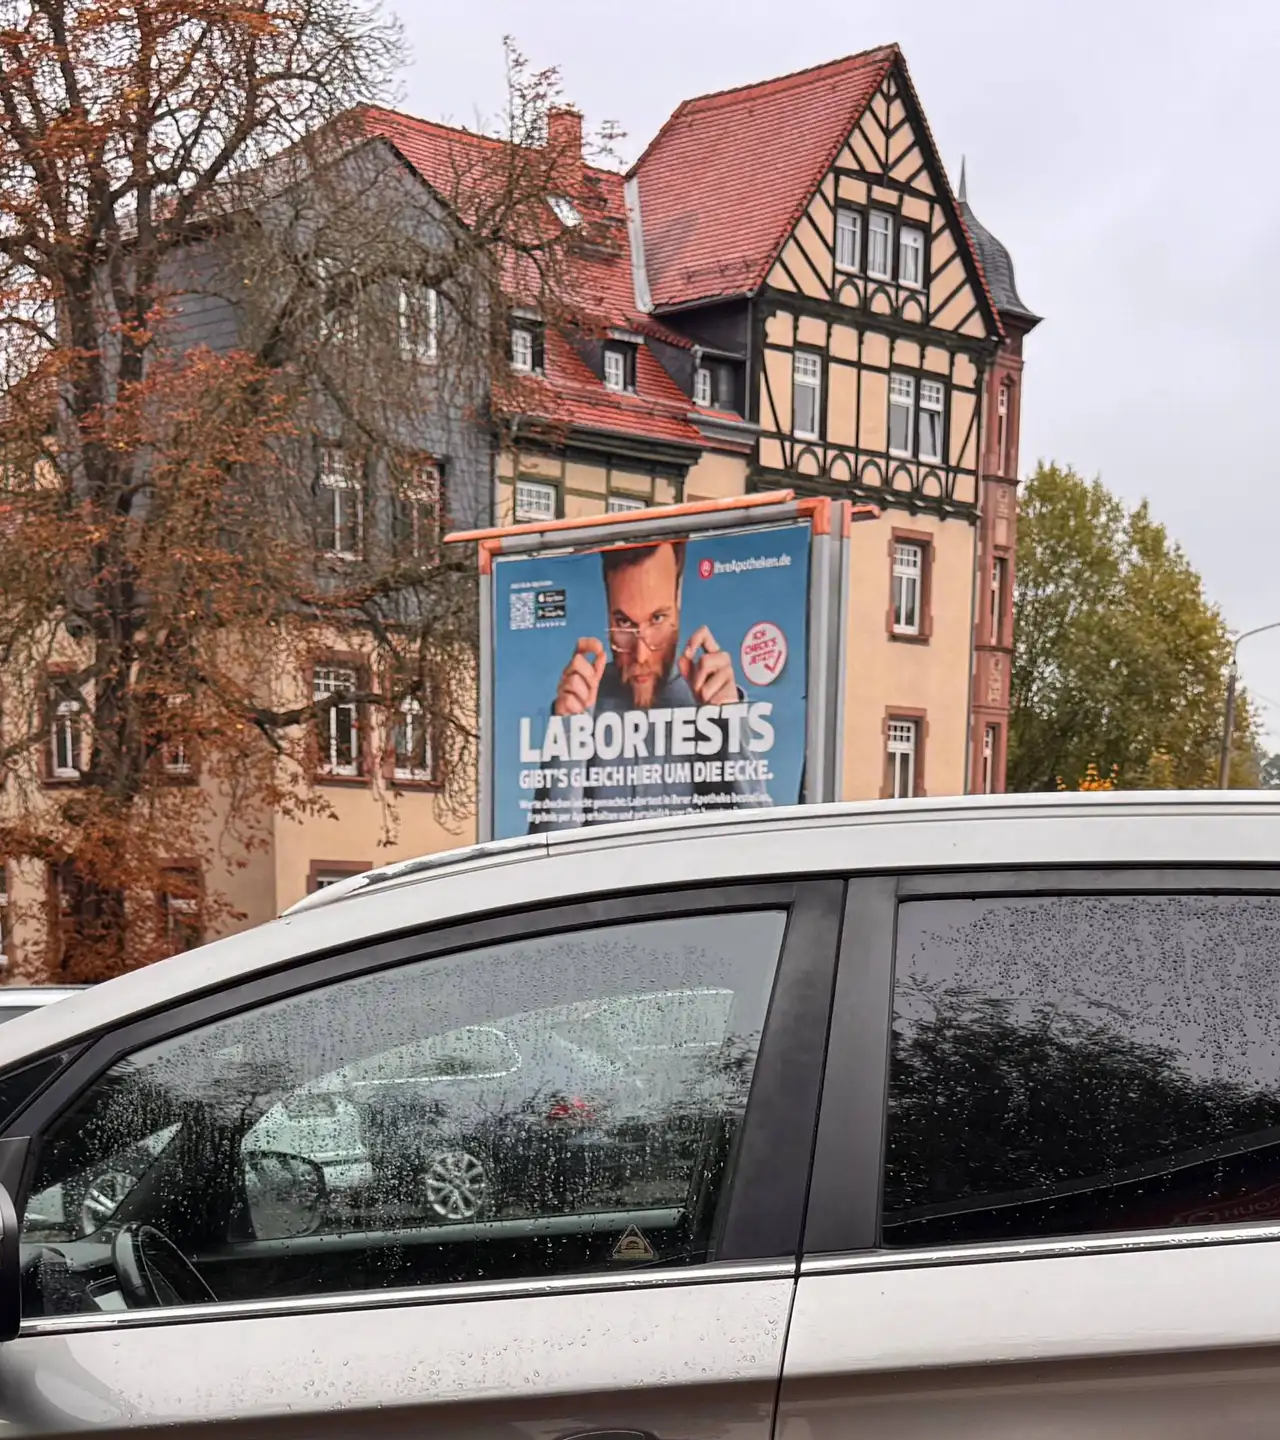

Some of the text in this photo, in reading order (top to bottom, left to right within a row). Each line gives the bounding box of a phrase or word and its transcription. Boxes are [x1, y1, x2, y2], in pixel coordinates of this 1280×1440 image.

[520, 702, 775, 763] LABORTESTS
[519, 768, 569, 789] GIBT'S
[570, 765, 625, 787] GLEICH
[664, 762, 691, 783] UM
[693, 761, 723, 783] DIE
[723, 759, 775, 782] ECKE.
[691, 791, 731, 806] Apotheke
